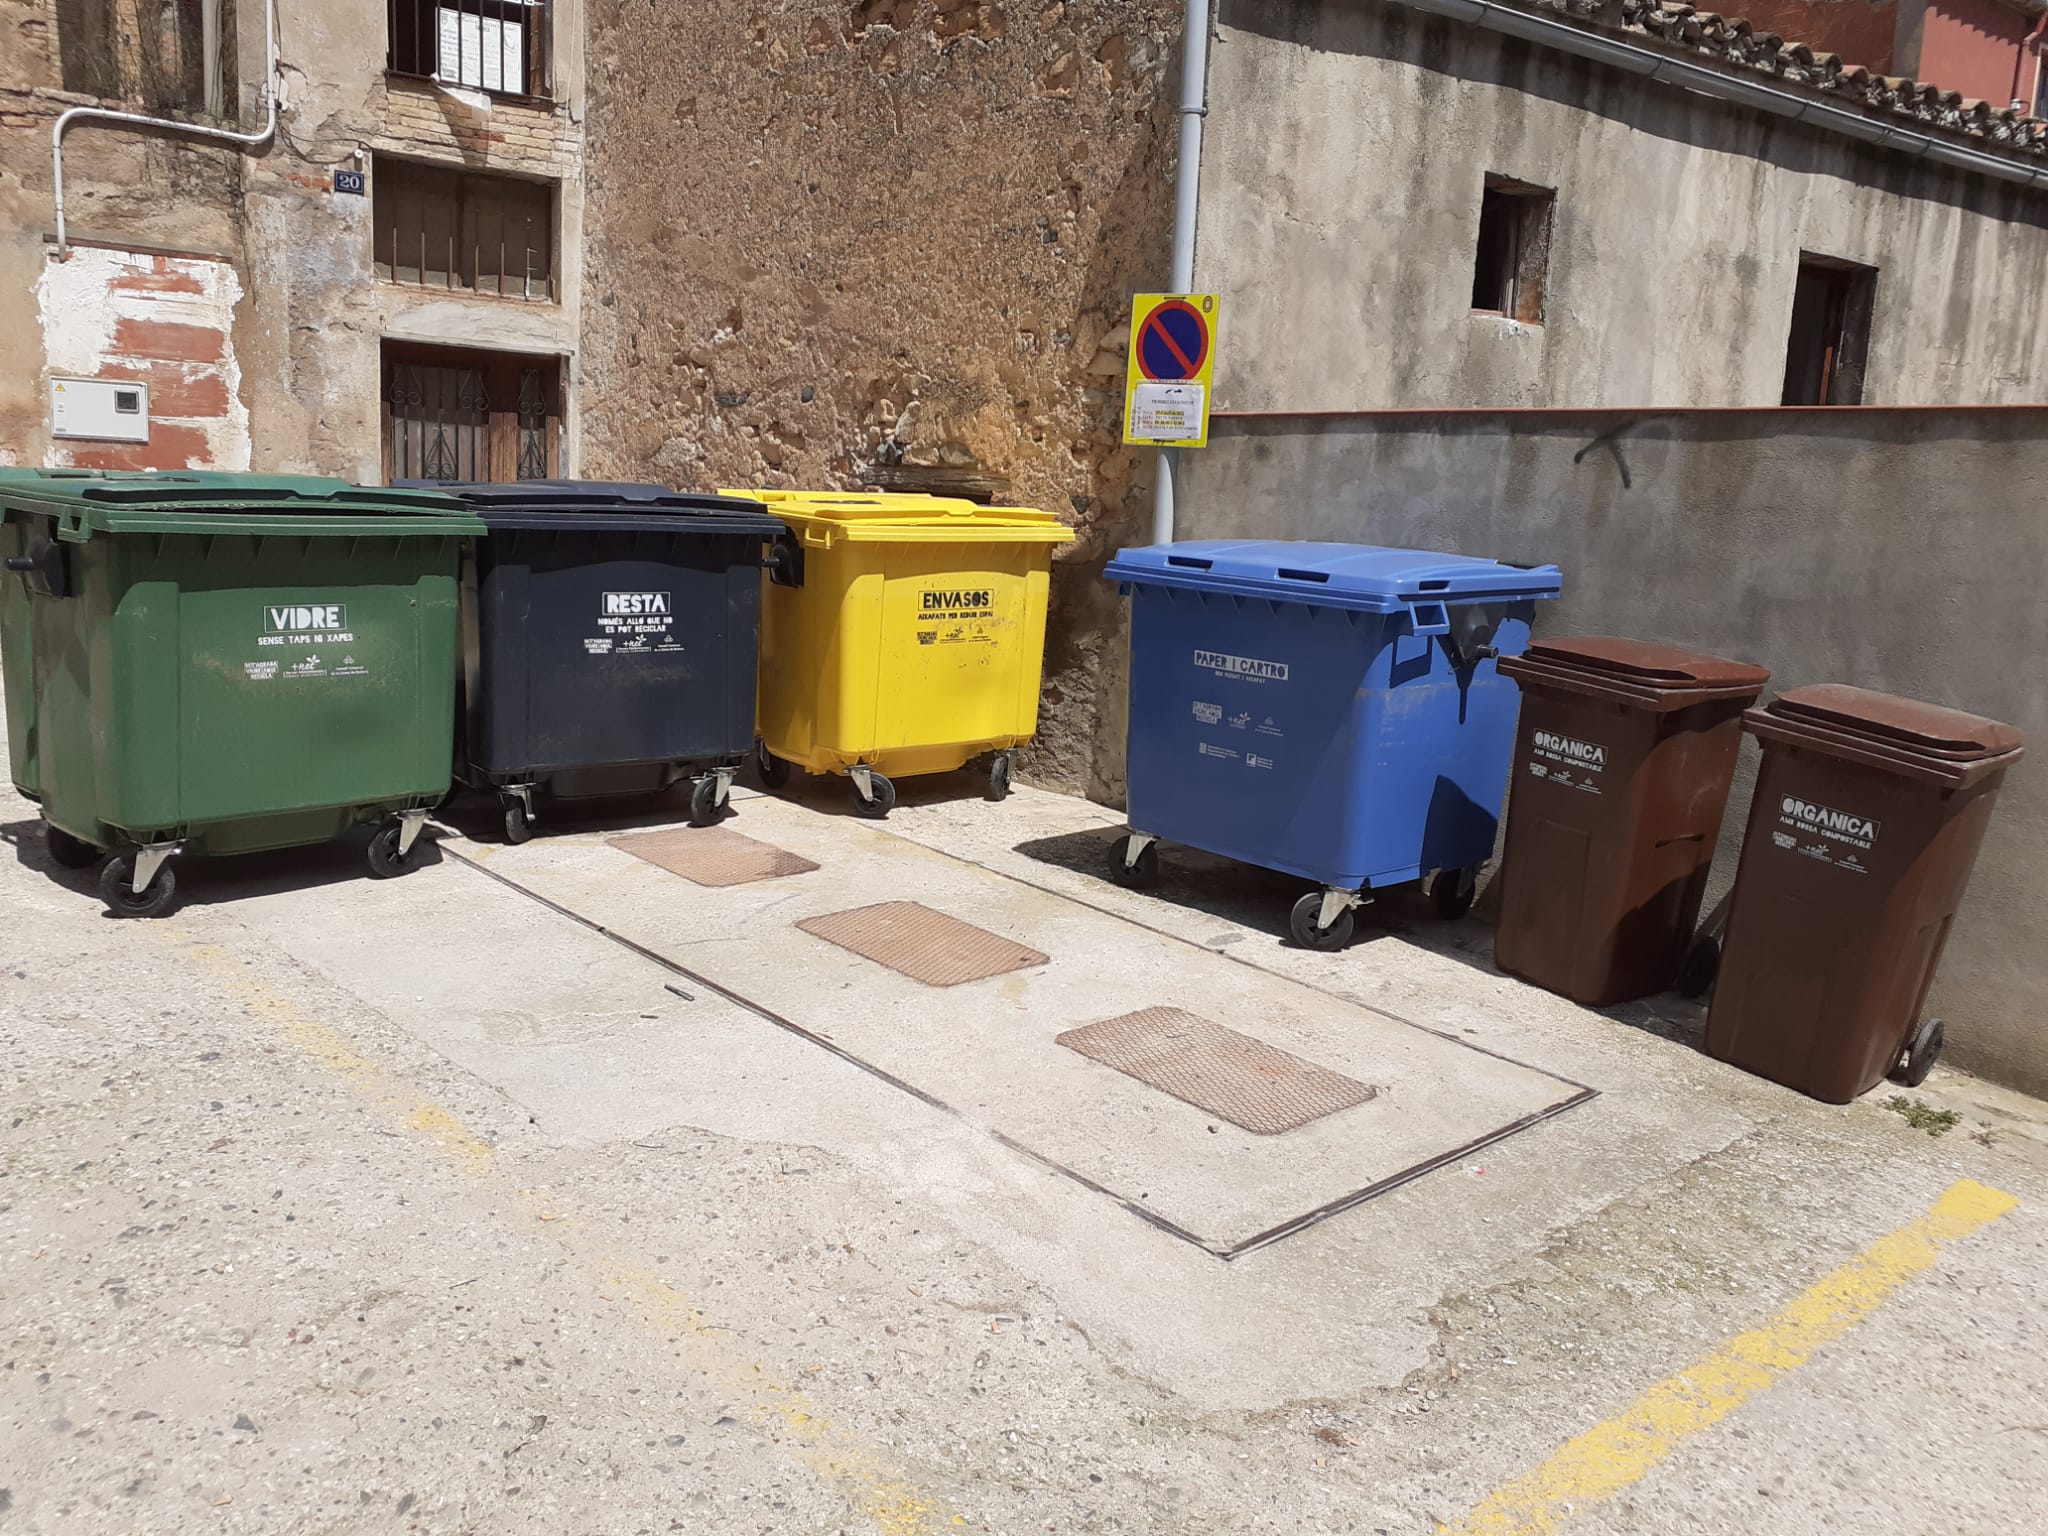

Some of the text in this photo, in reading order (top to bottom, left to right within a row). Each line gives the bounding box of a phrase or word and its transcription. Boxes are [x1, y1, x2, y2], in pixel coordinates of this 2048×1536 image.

[339, 175, 360, 189] 20
[607, 594, 666, 613] RESTA
[923, 591, 989, 609] ENVASOS
[270, 606, 340, 630] VIDRE
[646, 616, 660, 625] QUE
[663, 616, 673, 624] NO
[618, 625, 632, 633] POT
[635, 625, 666, 633] RECICLAR
[257, 633, 354, 646] SENSE TAPS NI XAPES
[1196, 652, 1228, 668] PAPER
[1232, 658, 1236, 670] I
[1563, 757, 1603, 772] COMPOSTABLE
[1780, 816, 1873, 850] AMB BOSSA COMPOSTABLE
